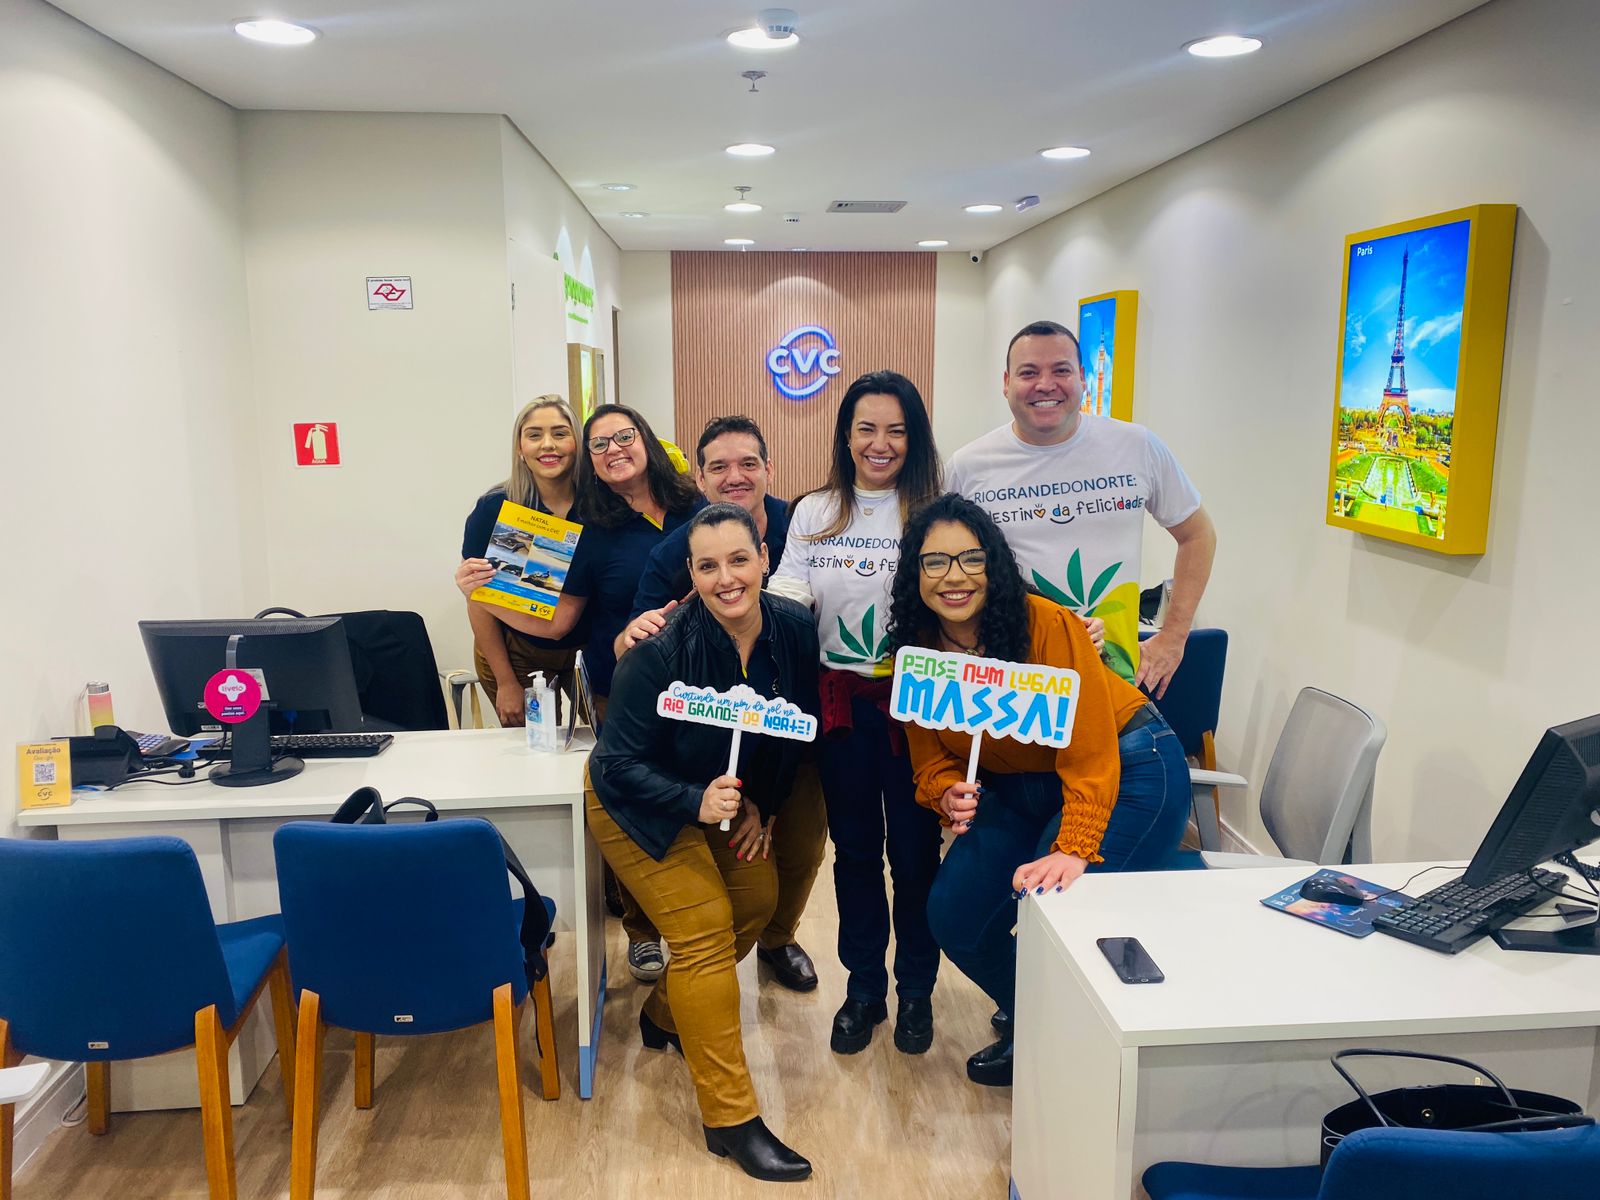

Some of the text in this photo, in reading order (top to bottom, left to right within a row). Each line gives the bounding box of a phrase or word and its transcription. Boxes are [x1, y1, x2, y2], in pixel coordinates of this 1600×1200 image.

[1357, 245, 1373, 257] Paris
[768, 348, 841, 374] CVC
[974, 474, 1137, 503] RIOGRANDEDONORTE:
[530, 515, 549, 526] NATAL
[1052, 503, 1071, 517] da
[859, 557, 874, 570] da
[902, 654, 1072, 696] PENSE NUM LUGAR
[673, 686, 716, 703] Curtindo
[717, 698, 732, 707] um
[752, 701, 765, 711] do
[767, 703, 782, 715] sol
[783, 709, 796, 717] no
[897, 672, 1070, 741] MASSA!
[688, 702, 738, 722] GRANDE
[743, 711, 760, 727] DO
[764, 714, 812, 735] NORTE!
[26, 746, 61, 755] Avaliação
